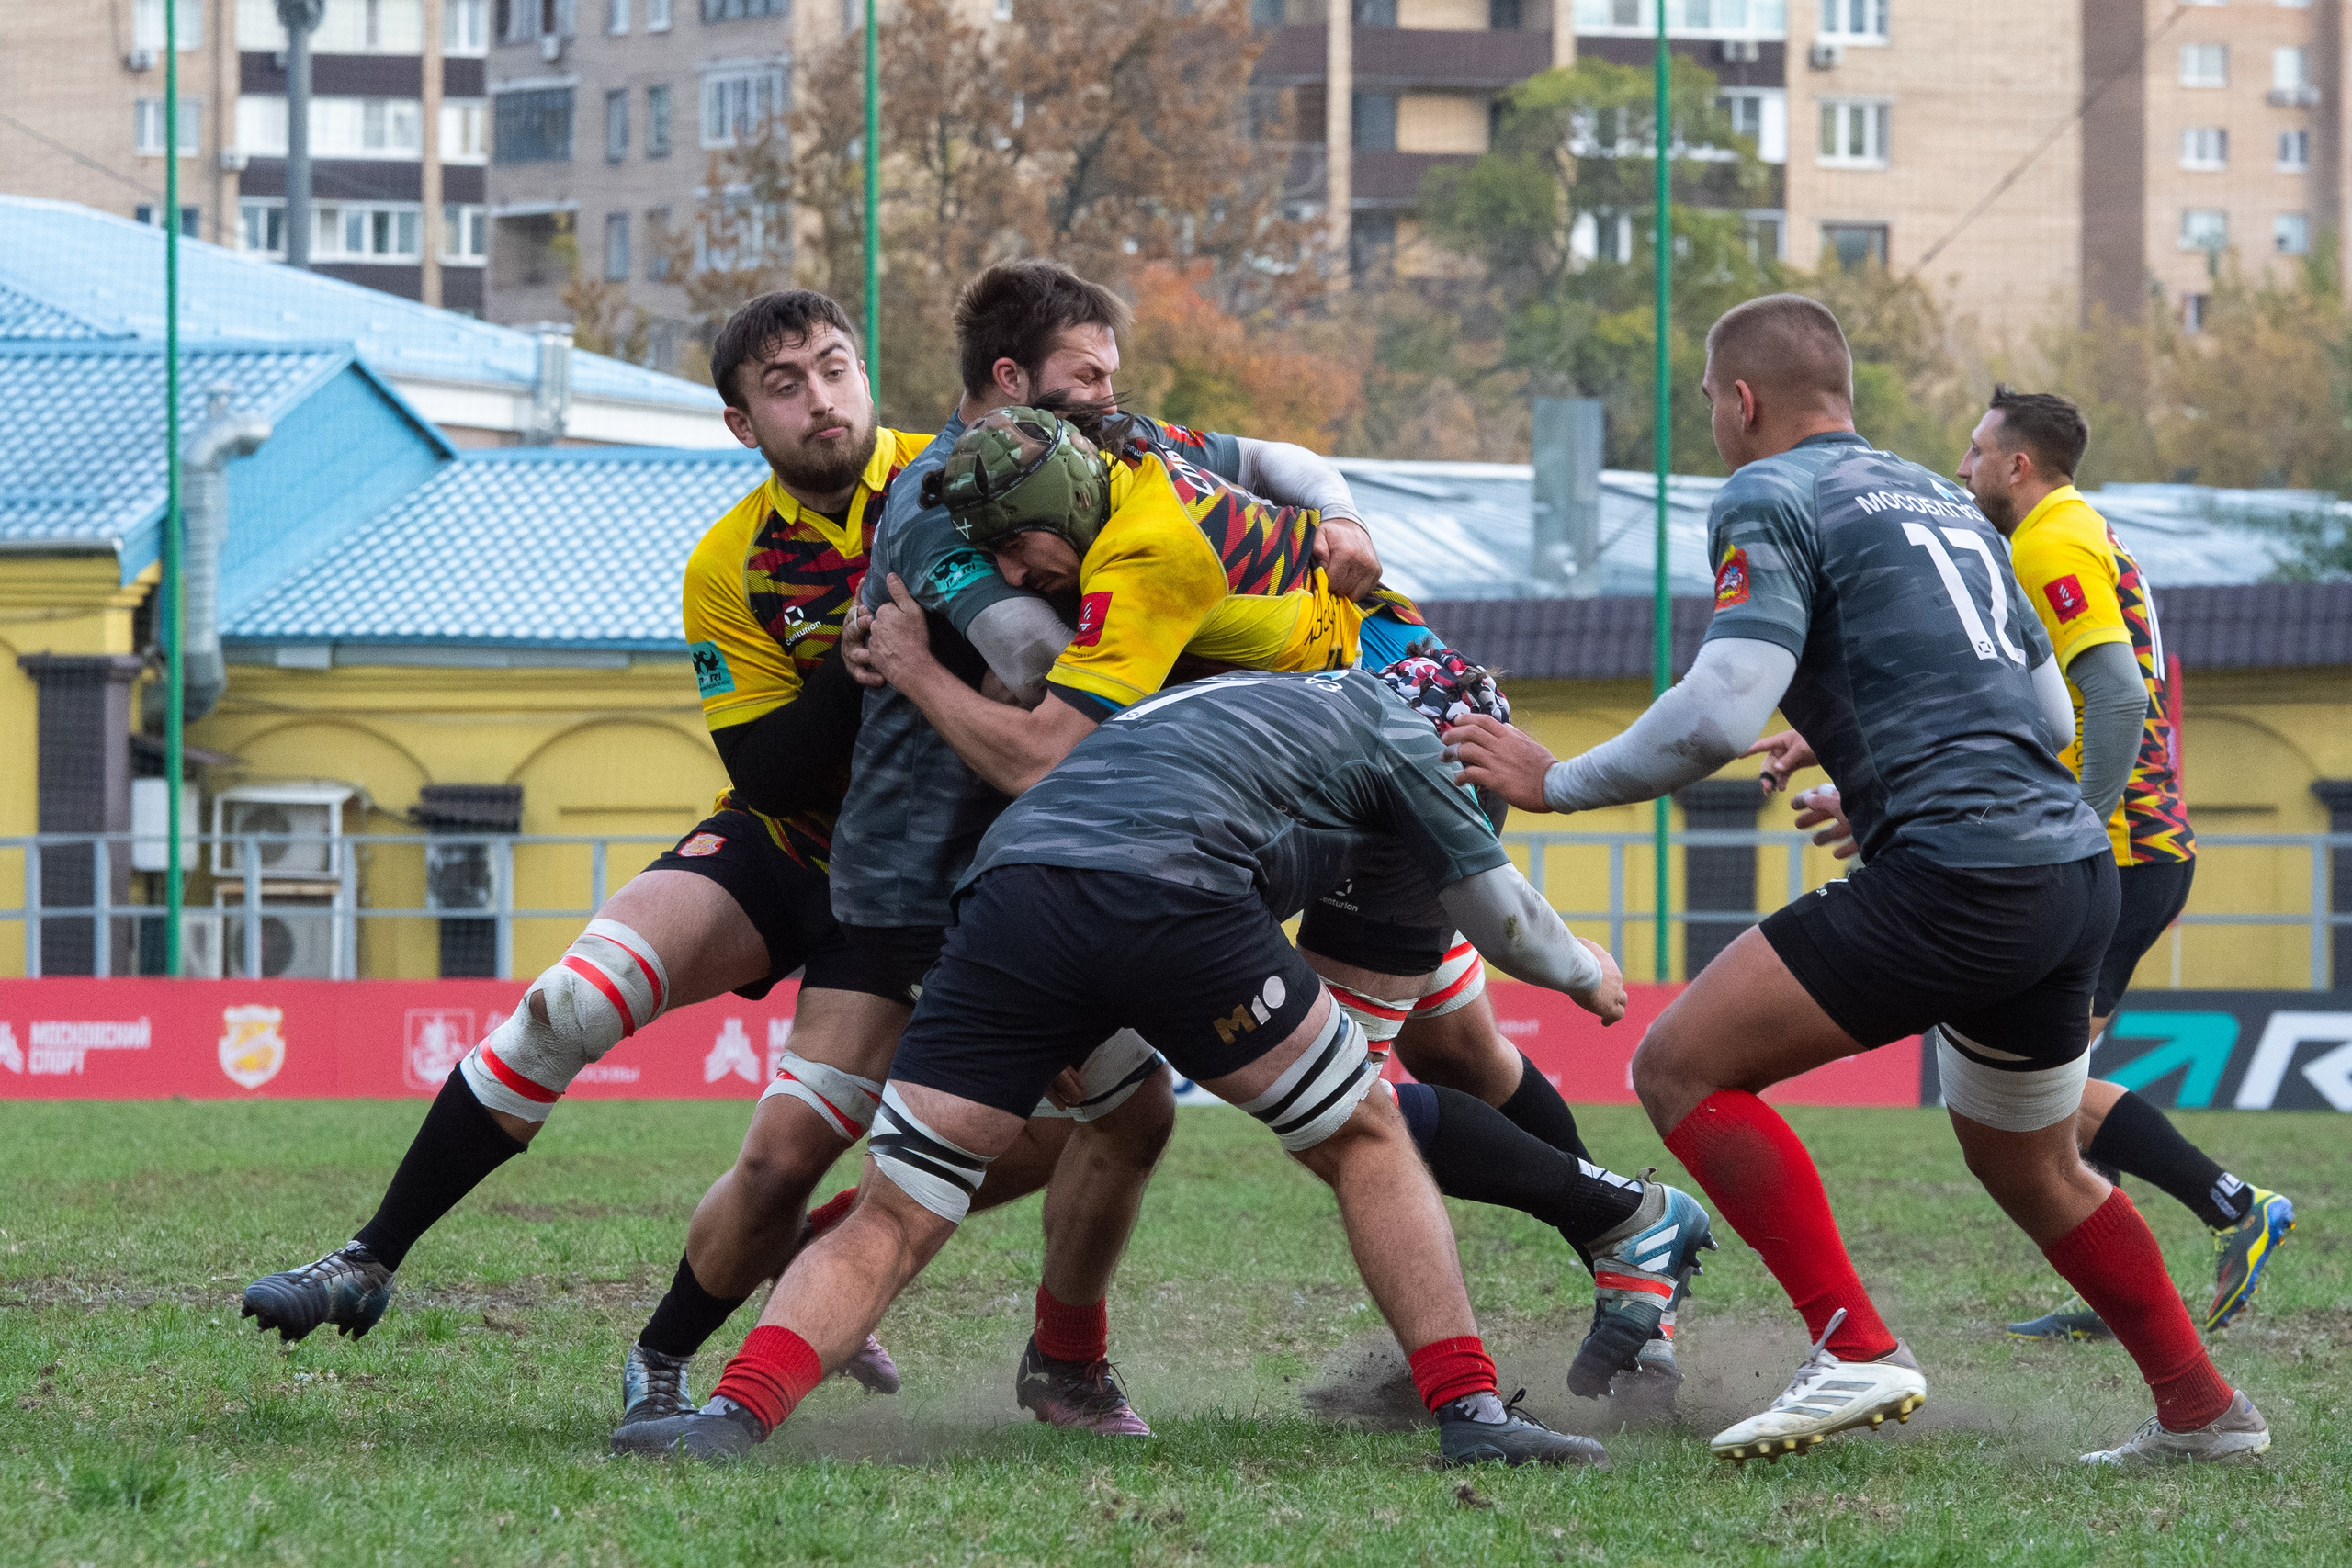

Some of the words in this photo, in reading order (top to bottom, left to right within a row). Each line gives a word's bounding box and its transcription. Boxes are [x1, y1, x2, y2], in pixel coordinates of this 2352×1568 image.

[1854, 491, 1986, 523] МОСОБЛГАЗ
[1901, 522, 2027, 667] 17
[786, 620, 822, 646] centurion
[1319, 897, 1359, 912] enturion
